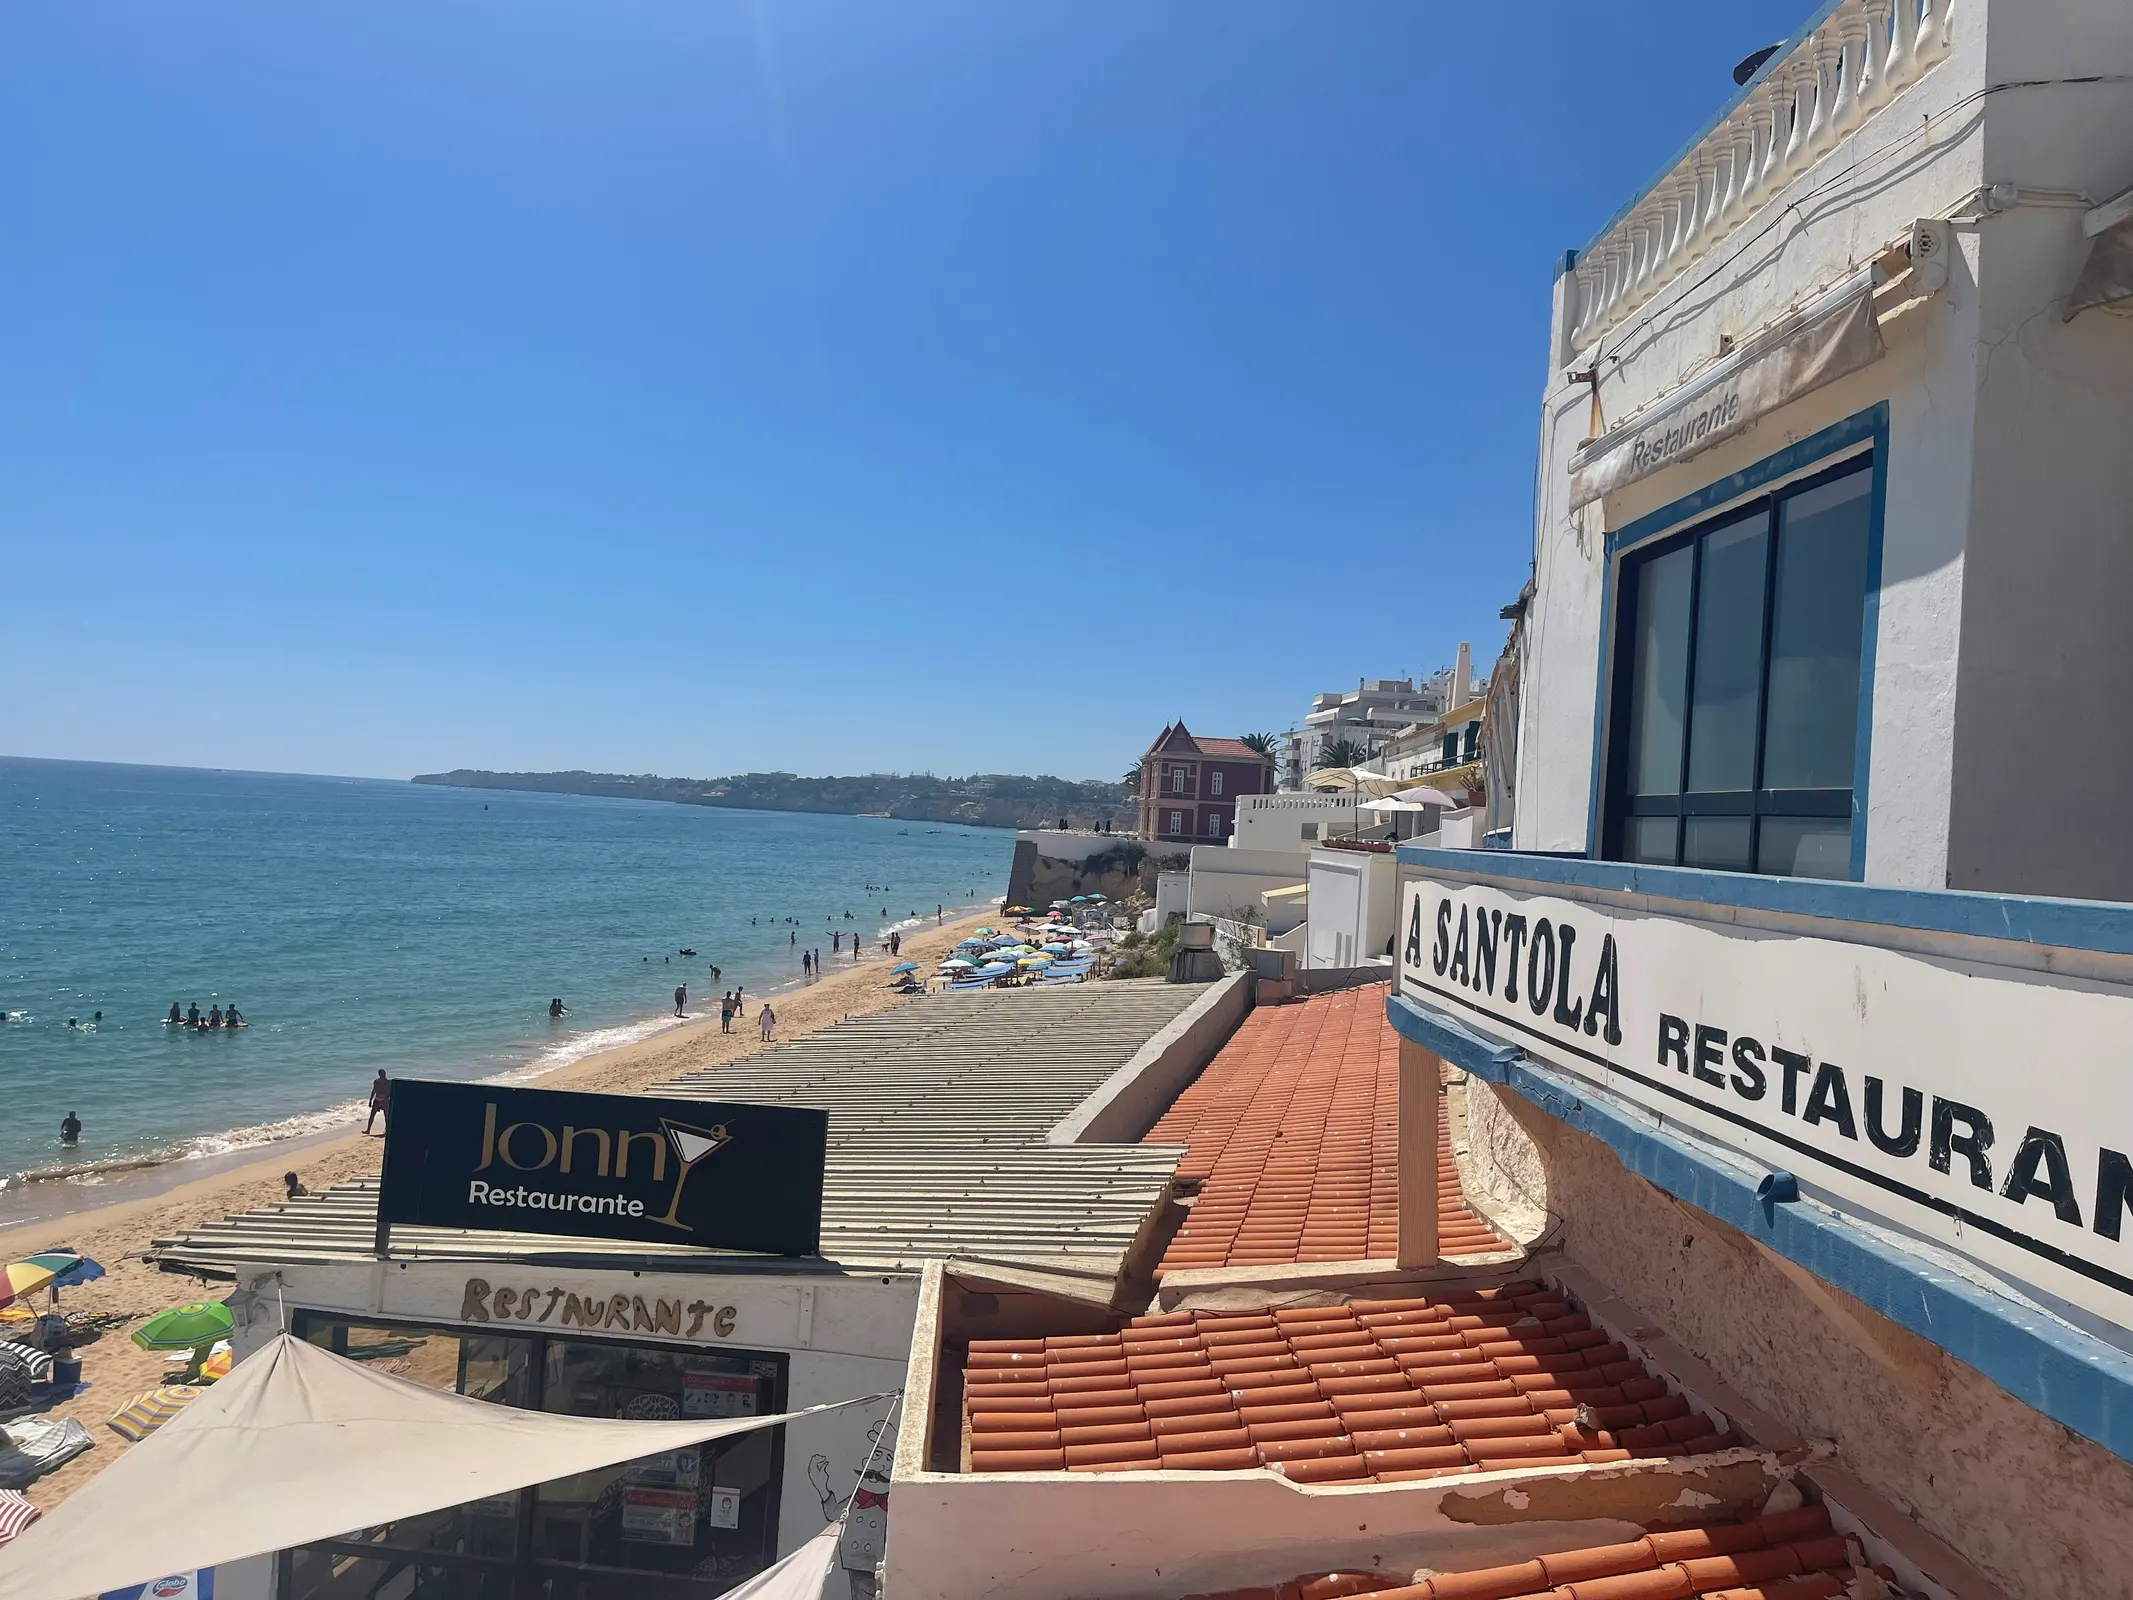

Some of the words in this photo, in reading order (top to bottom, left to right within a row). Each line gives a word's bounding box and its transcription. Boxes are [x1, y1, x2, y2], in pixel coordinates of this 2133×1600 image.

[1630, 392, 1740, 474] Restaurante
[1405, 893, 1421, 968] A
[1433, 899, 1622, 1046] SANTOLA
[468, 1180, 645, 1217] Restaurante
[156, 1578, 187, 1589] Globo
